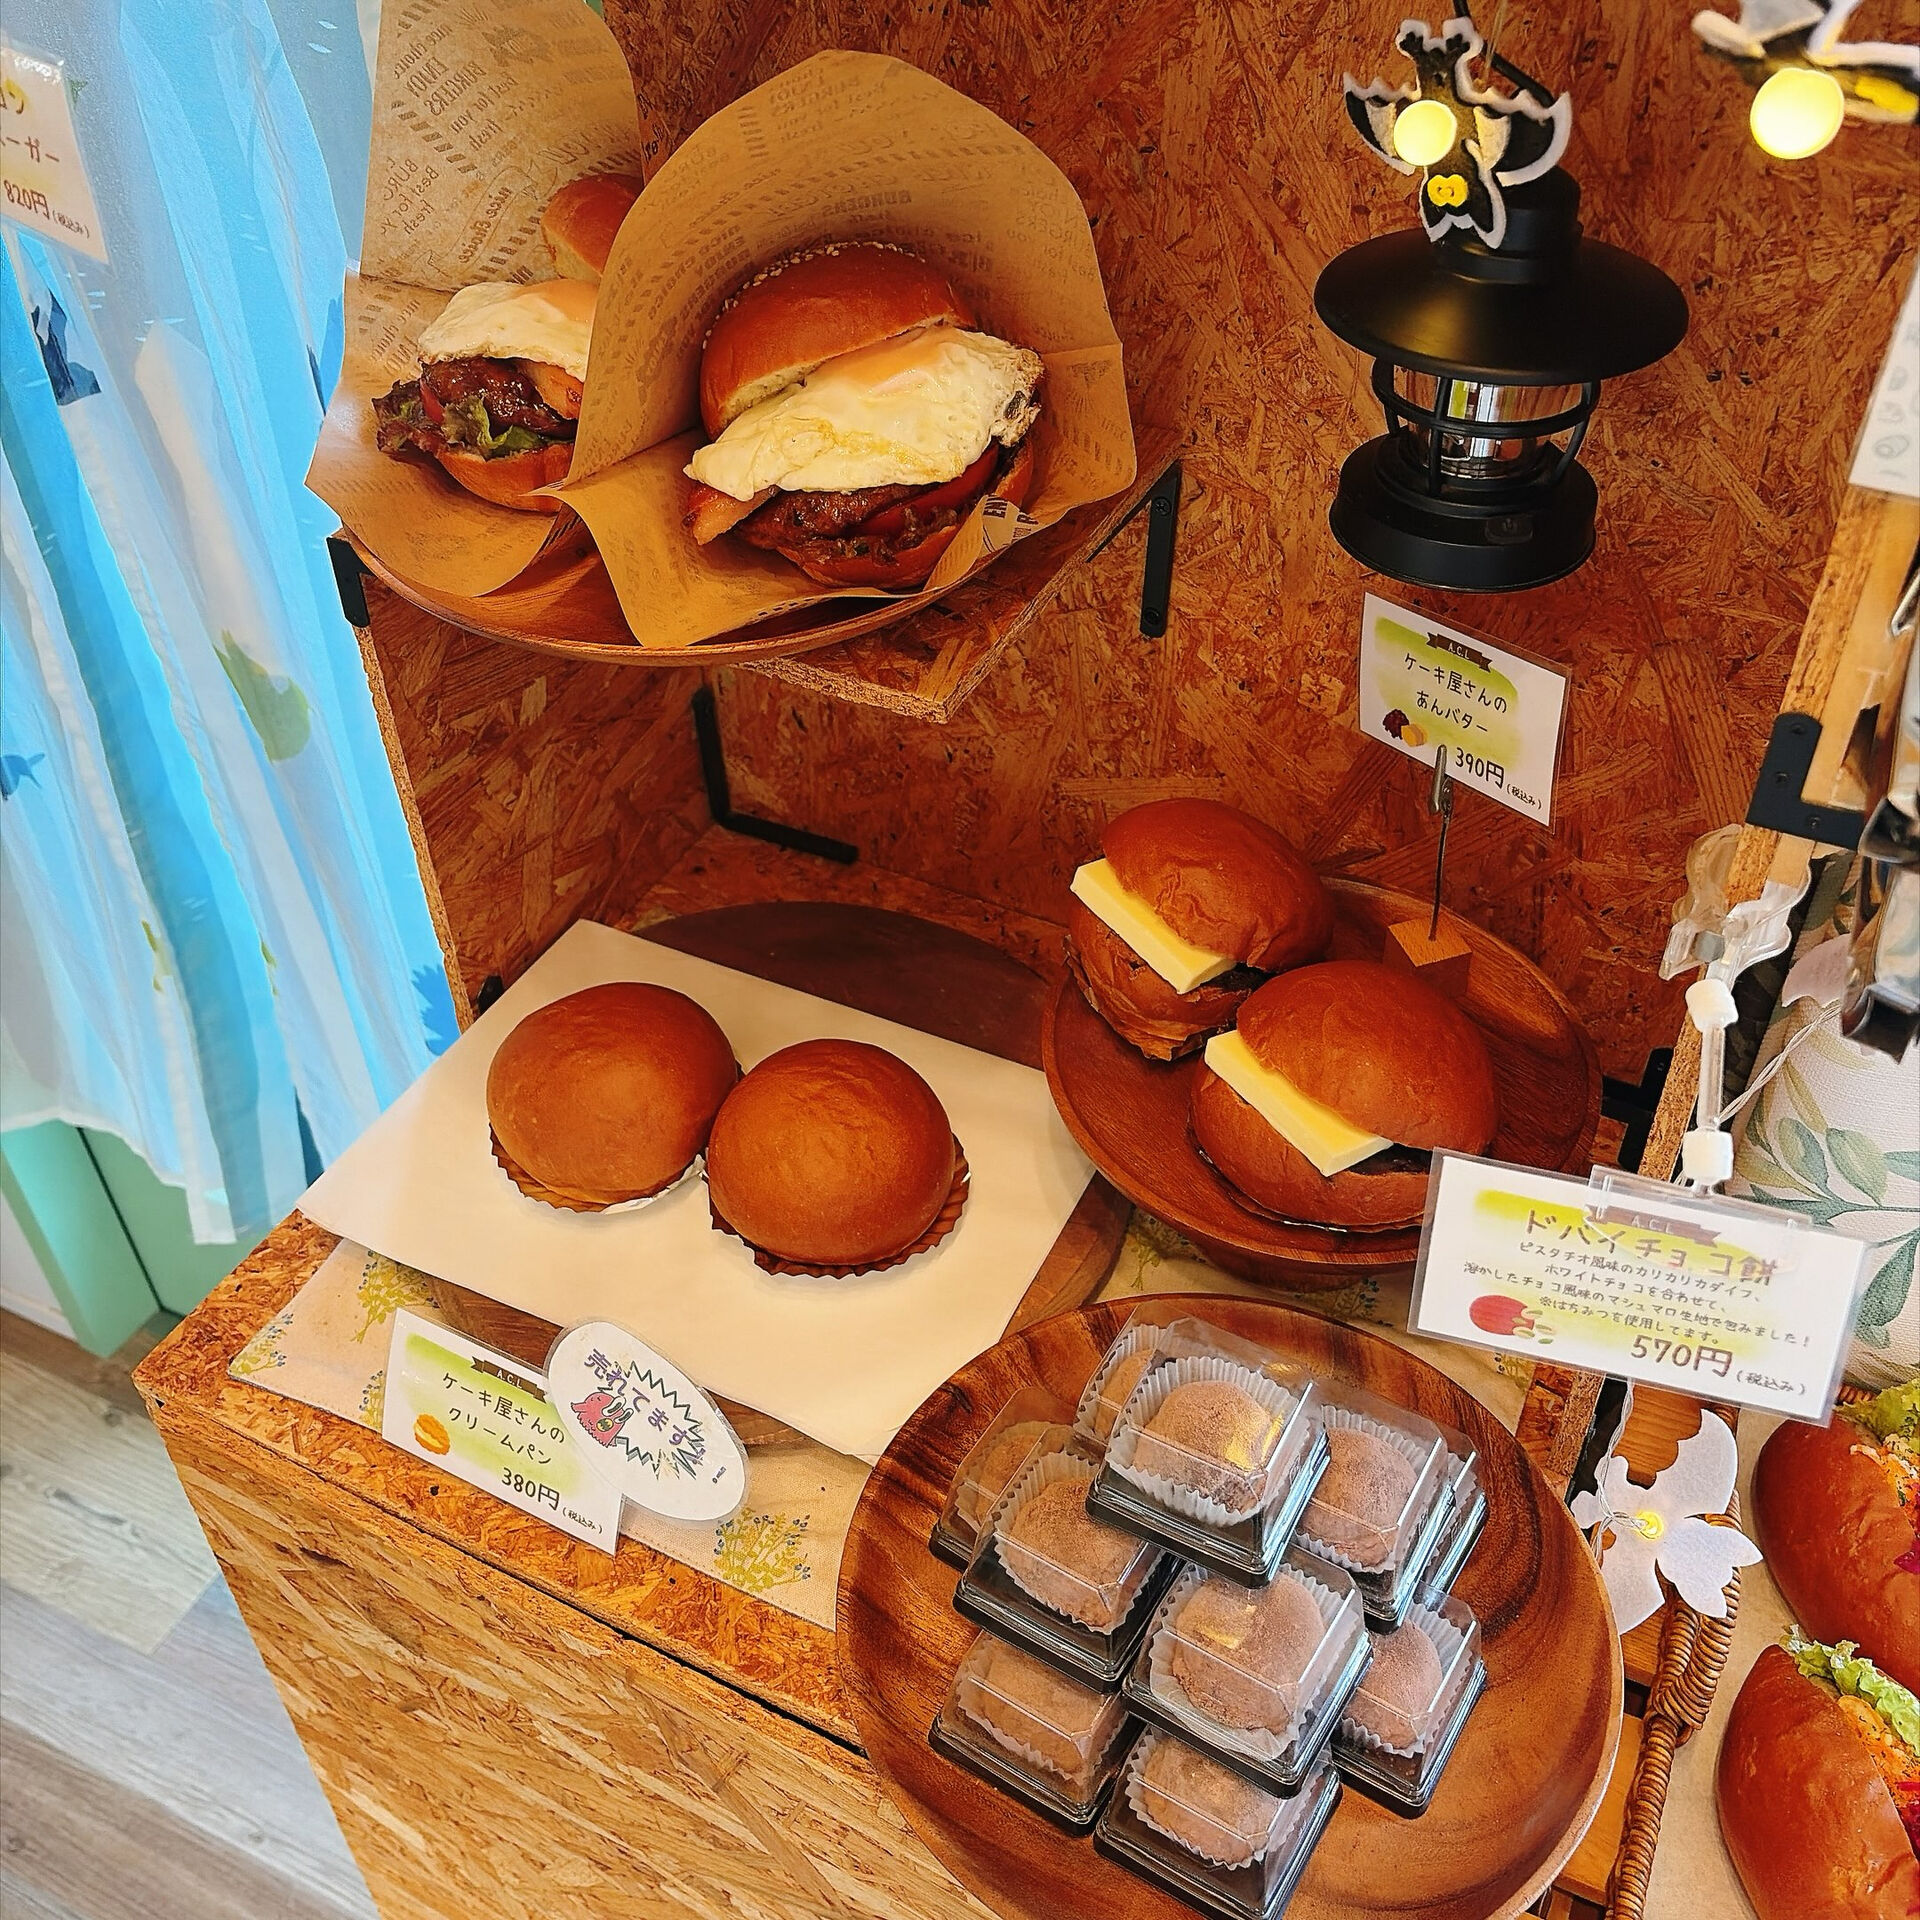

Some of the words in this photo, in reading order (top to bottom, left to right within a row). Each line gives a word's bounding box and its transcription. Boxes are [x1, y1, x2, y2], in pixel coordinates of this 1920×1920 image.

[4, 179, 50, 220] 820円
[1404, 652, 1508, 714] ケーキ屋さんの
[1416, 690, 1488, 733] あんバター
[1455, 747, 1505, 790] 390円
[1519, 1241, 1761, 1302] ピスタチオ風味のカリカリカダイフ、
[1526, 1208, 1778, 1286] ドバイチョコ餅
[1545, 1264, 1727, 1313] ホワイトチョコを合わせて、
[1539, 1295, 1719, 1345] ※はちみつを使用してます。
[1631, 1334, 1733, 1378] 570円
[443, 1372, 565, 1444] ケーキ屋さんの
[448, 1407, 552, 1466] クリームパン
[501, 1467, 561, 1512] 380円
